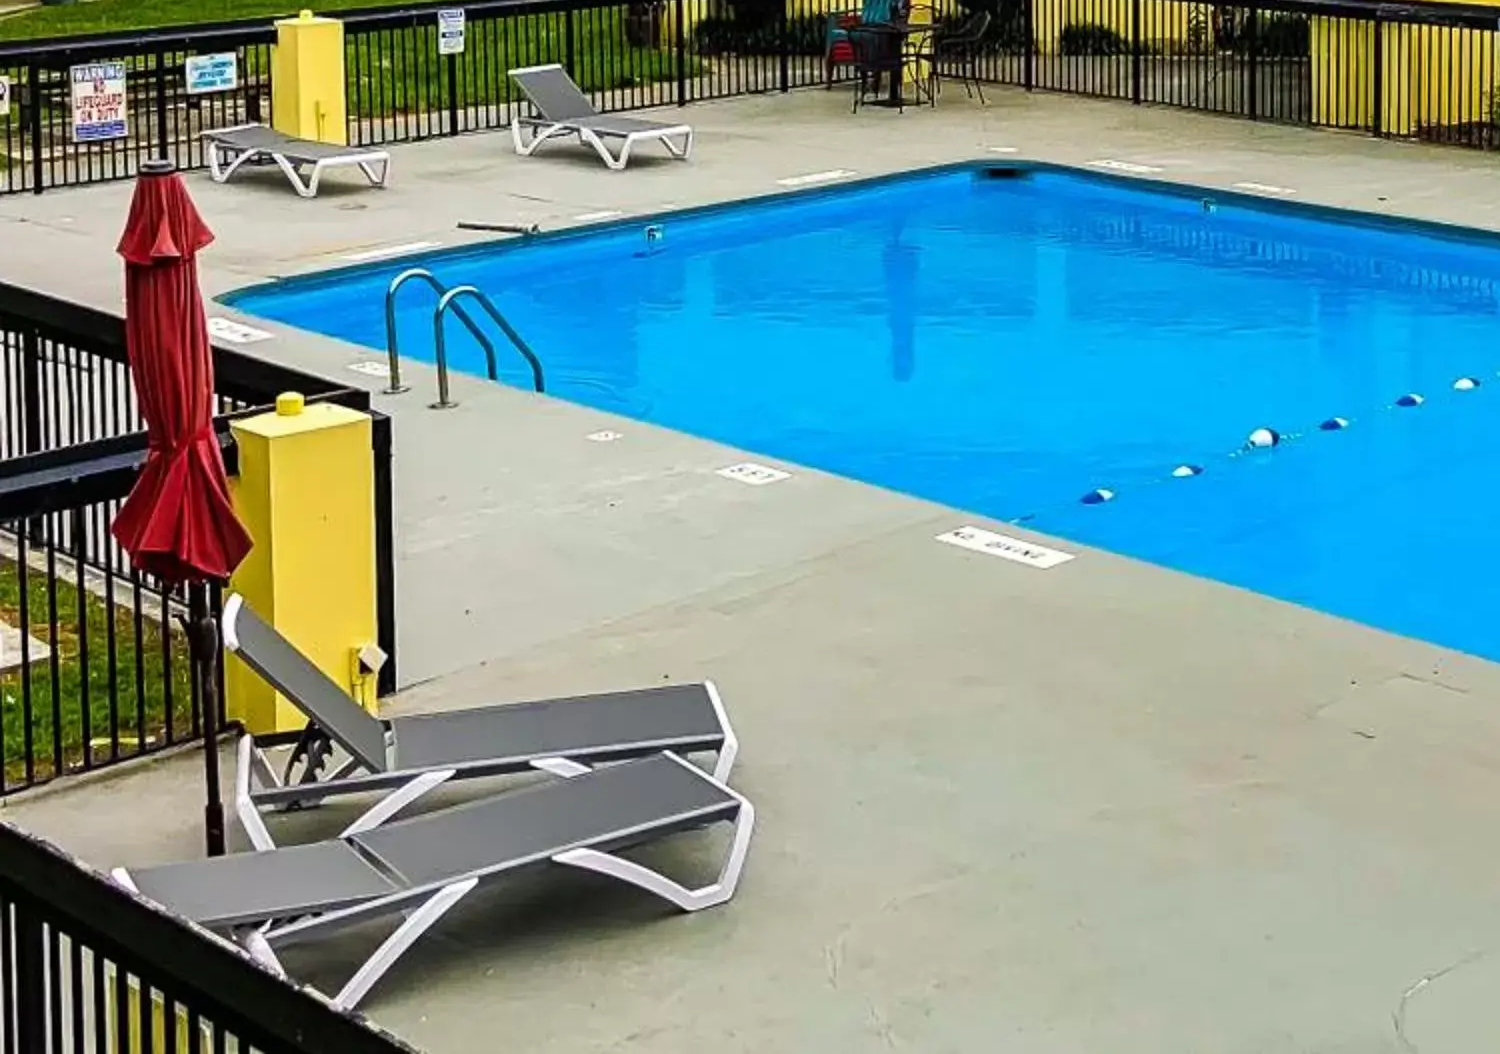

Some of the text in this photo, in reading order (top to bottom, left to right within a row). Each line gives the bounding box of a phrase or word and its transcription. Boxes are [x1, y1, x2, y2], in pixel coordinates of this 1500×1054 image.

[74, 64, 124, 82] WARNING
[93, 77, 104, 93] NO
[76, 93, 122, 110] LIFEGUARD
[81, 106, 119, 123] ON DUTY
